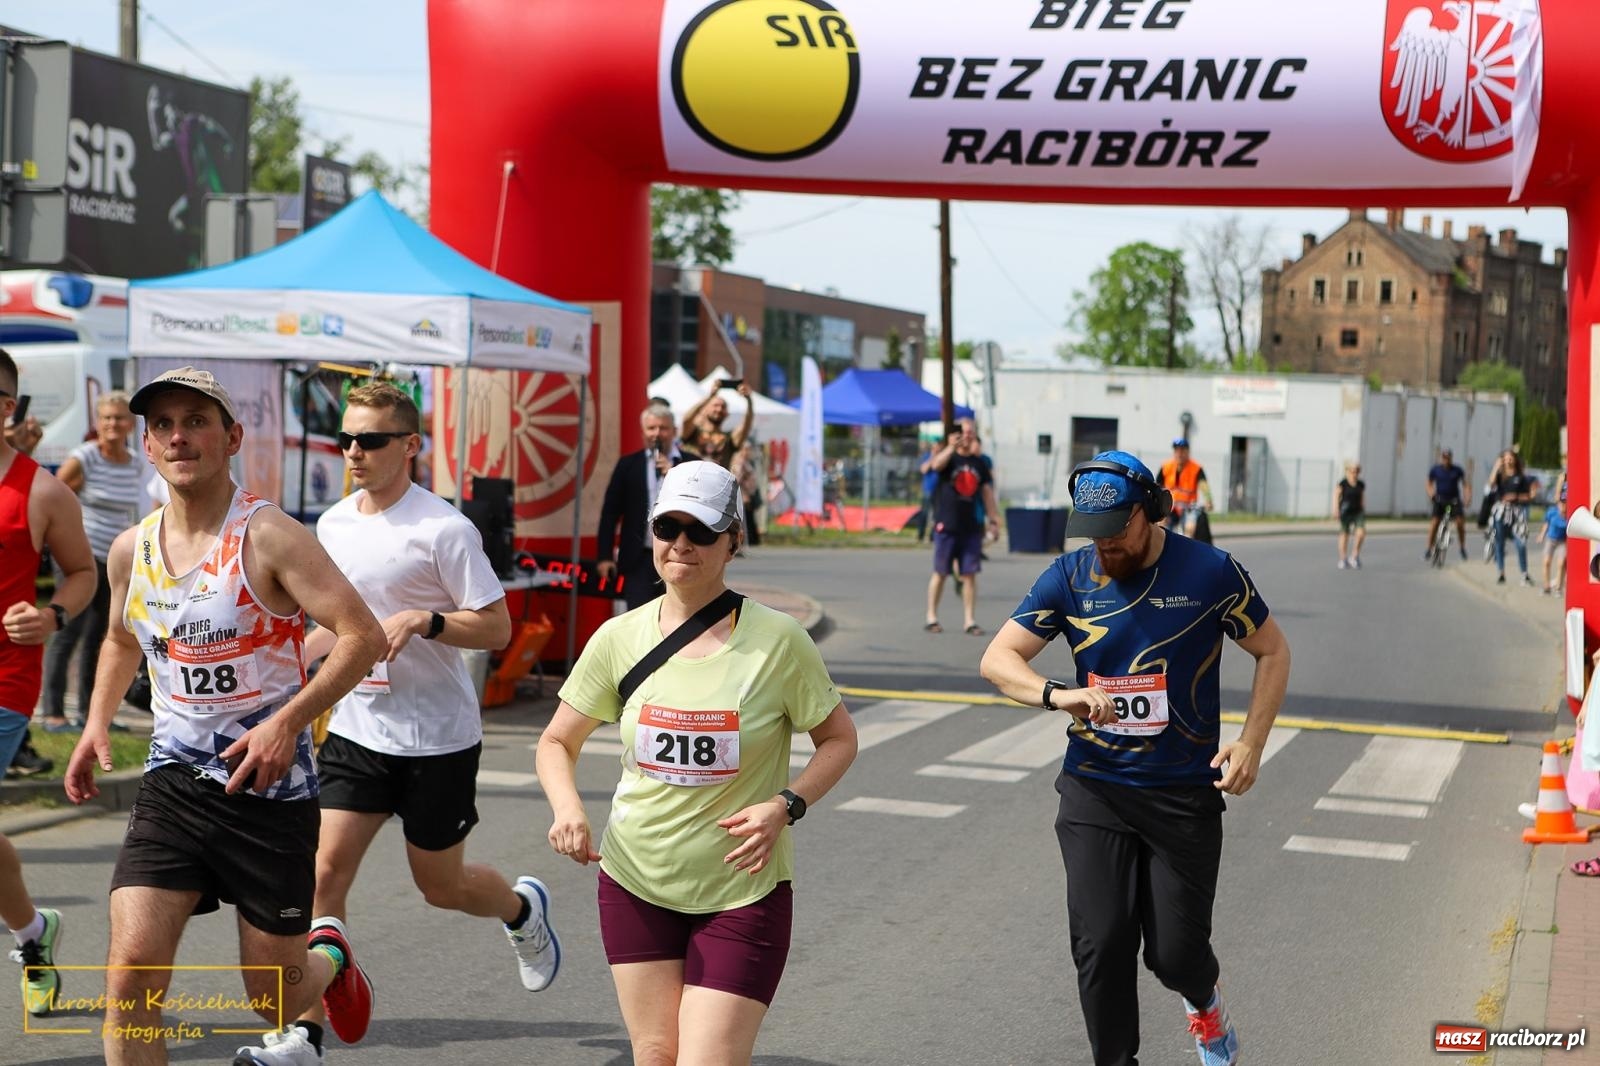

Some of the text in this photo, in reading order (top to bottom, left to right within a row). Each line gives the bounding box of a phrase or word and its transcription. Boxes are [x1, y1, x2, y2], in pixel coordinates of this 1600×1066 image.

[1030, 0, 1191, 30] BIEG
[766, 15, 856, 48] SIR
[910, 57, 1308, 101] BEZ GRANIC
[942, 118, 1271, 168] RACIBÓRZ
[1165, 595, 1189, 603] SILESIA
[1165, 601, 1202, 609] MARATHON
[188, 618, 211, 635] BIEG
[209, 641, 239, 652] GRANIC
[180, 664, 238, 695] 128
[1116, 678, 1129, 686] BEZ
[1129, 676, 1155, 685] GRANIC
[678, 713, 693, 721] BEZ
[693, 713, 727, 721] GRANIC
[655, 732, 717, 767] 218
